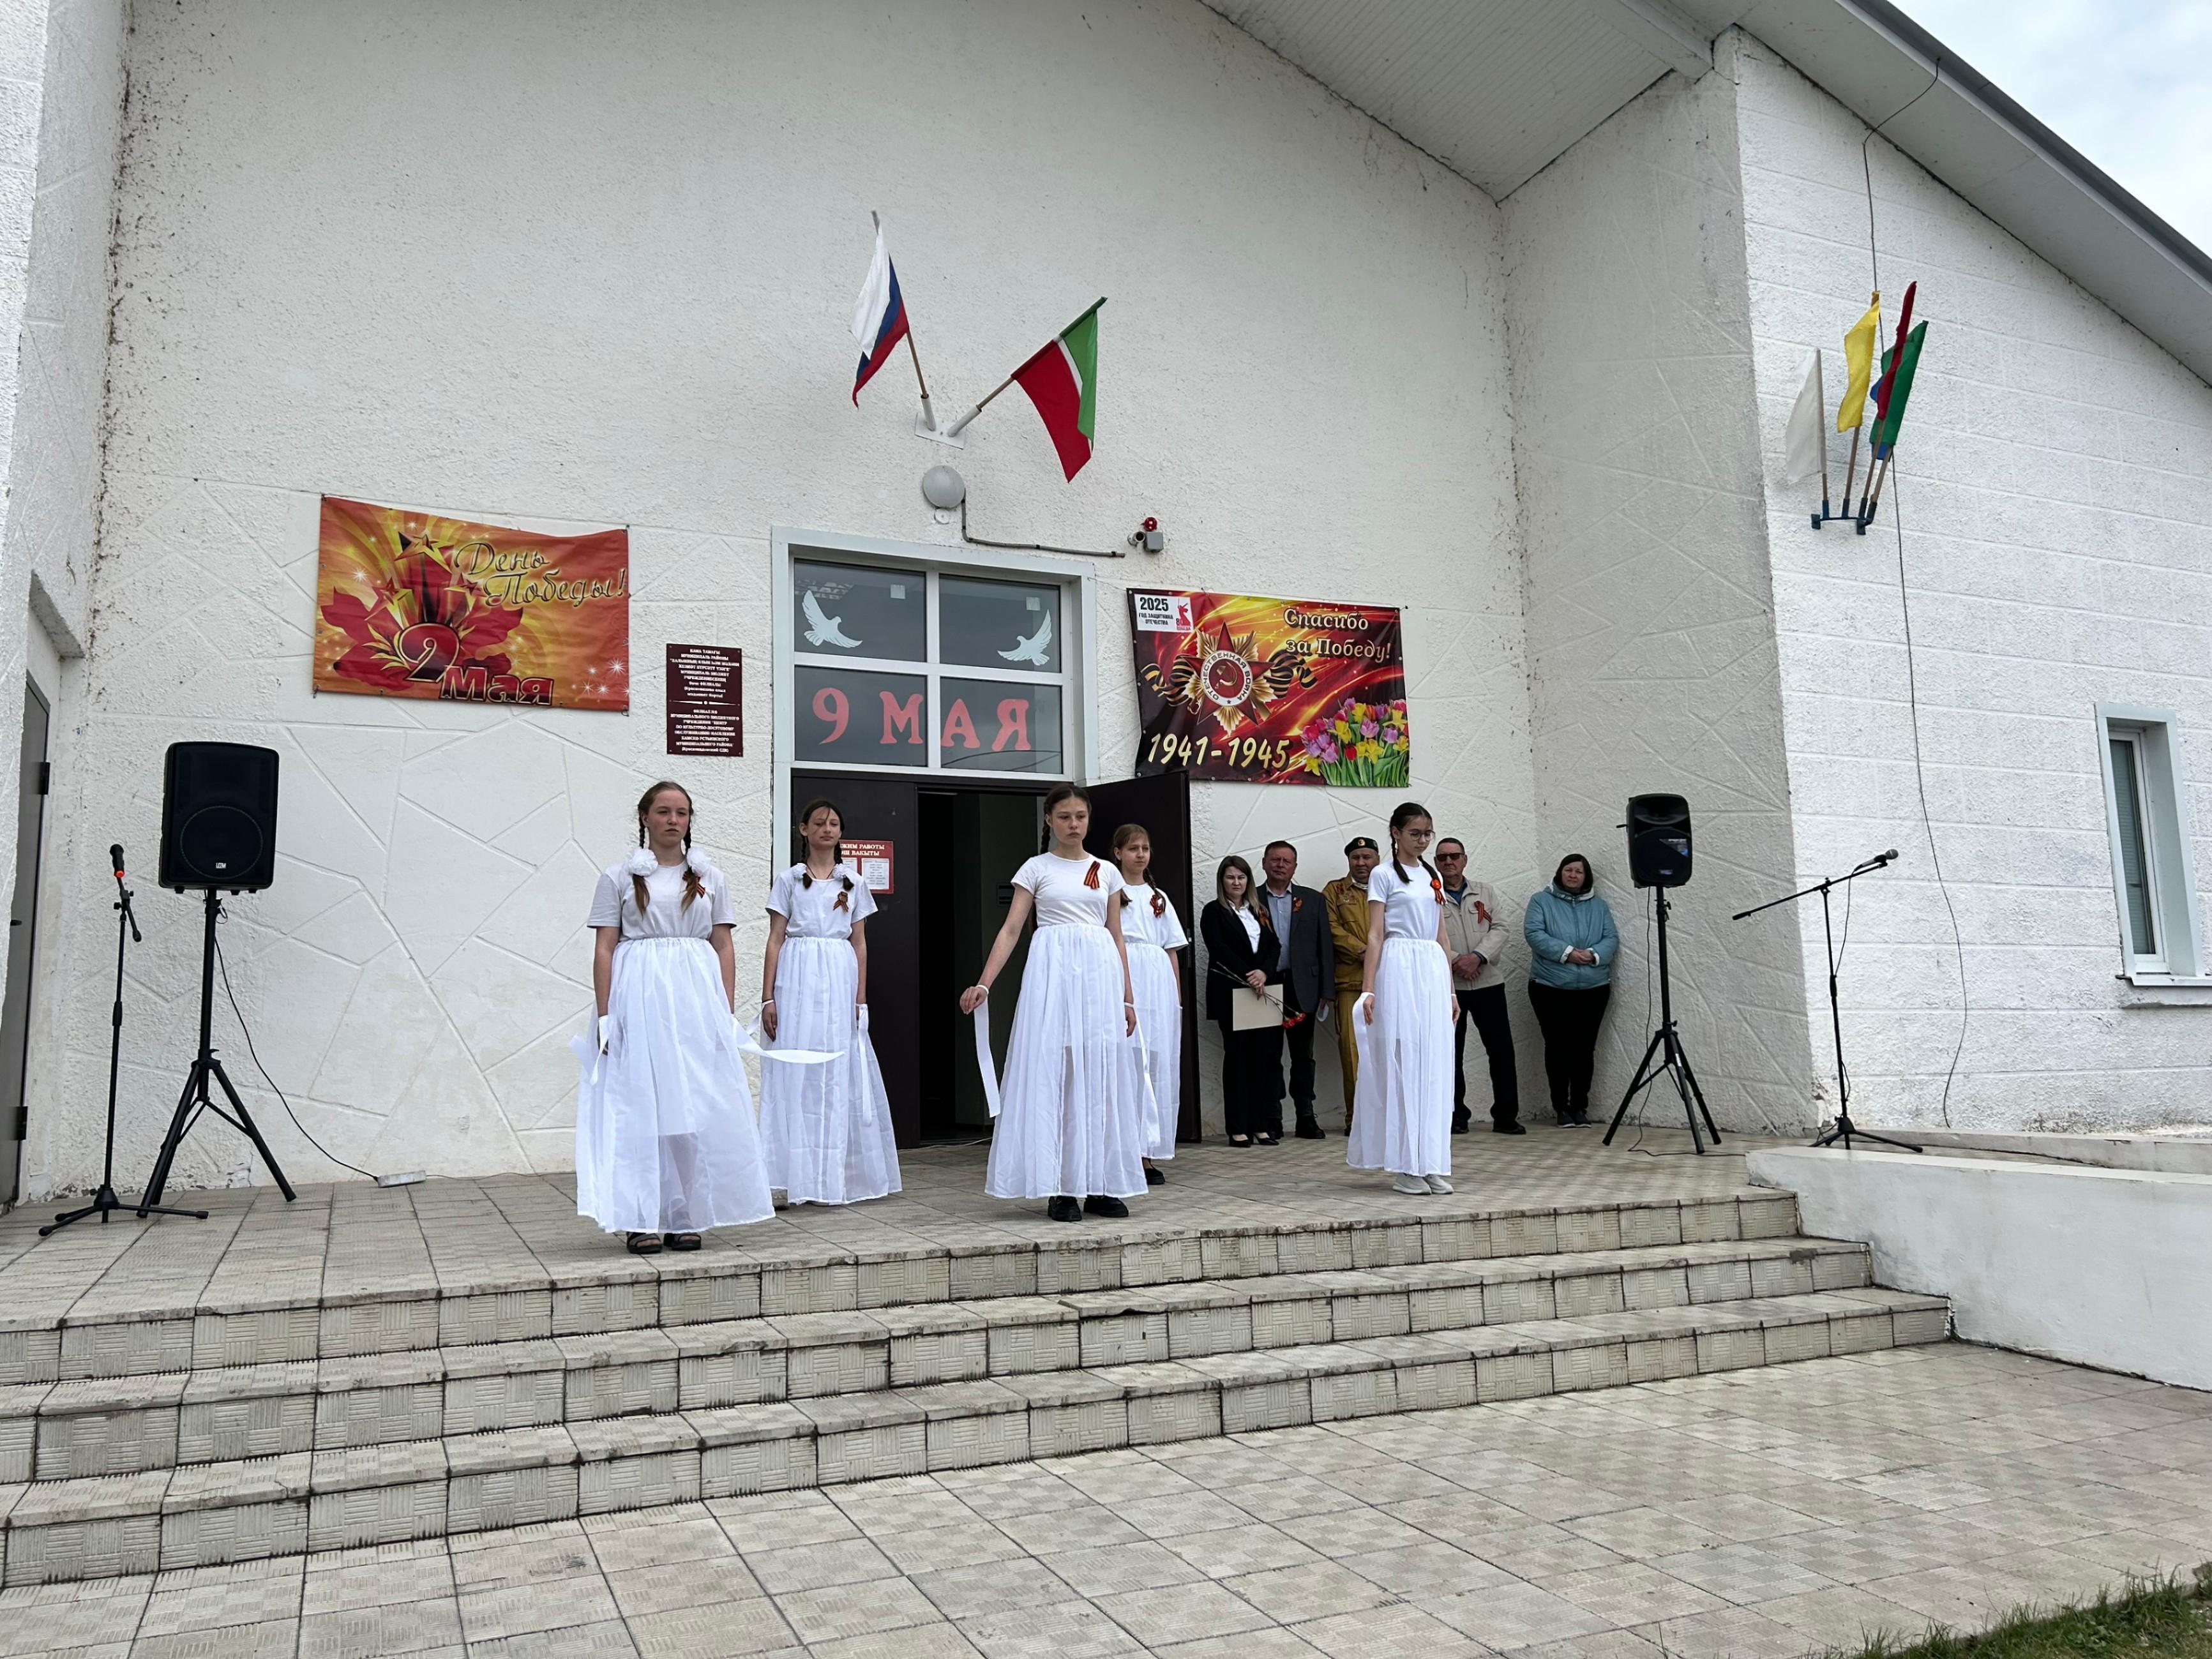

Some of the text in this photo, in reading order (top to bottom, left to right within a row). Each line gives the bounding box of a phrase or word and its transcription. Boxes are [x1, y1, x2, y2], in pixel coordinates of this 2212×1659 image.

[453, 543, 550, 575] День
[483, 569, 626, 607] Победы!
[1140, 597, 1169, 612] 2025
[1284, 608, 1369, 630] Спасибо
[398, 623, 554, 705] 9 Мая
[1286, 638, 1392, 663] за Победу!
[812, 687, 1032, 752] 9 МАЯ
[1148, 733, 1290, 769] 1941-1945
